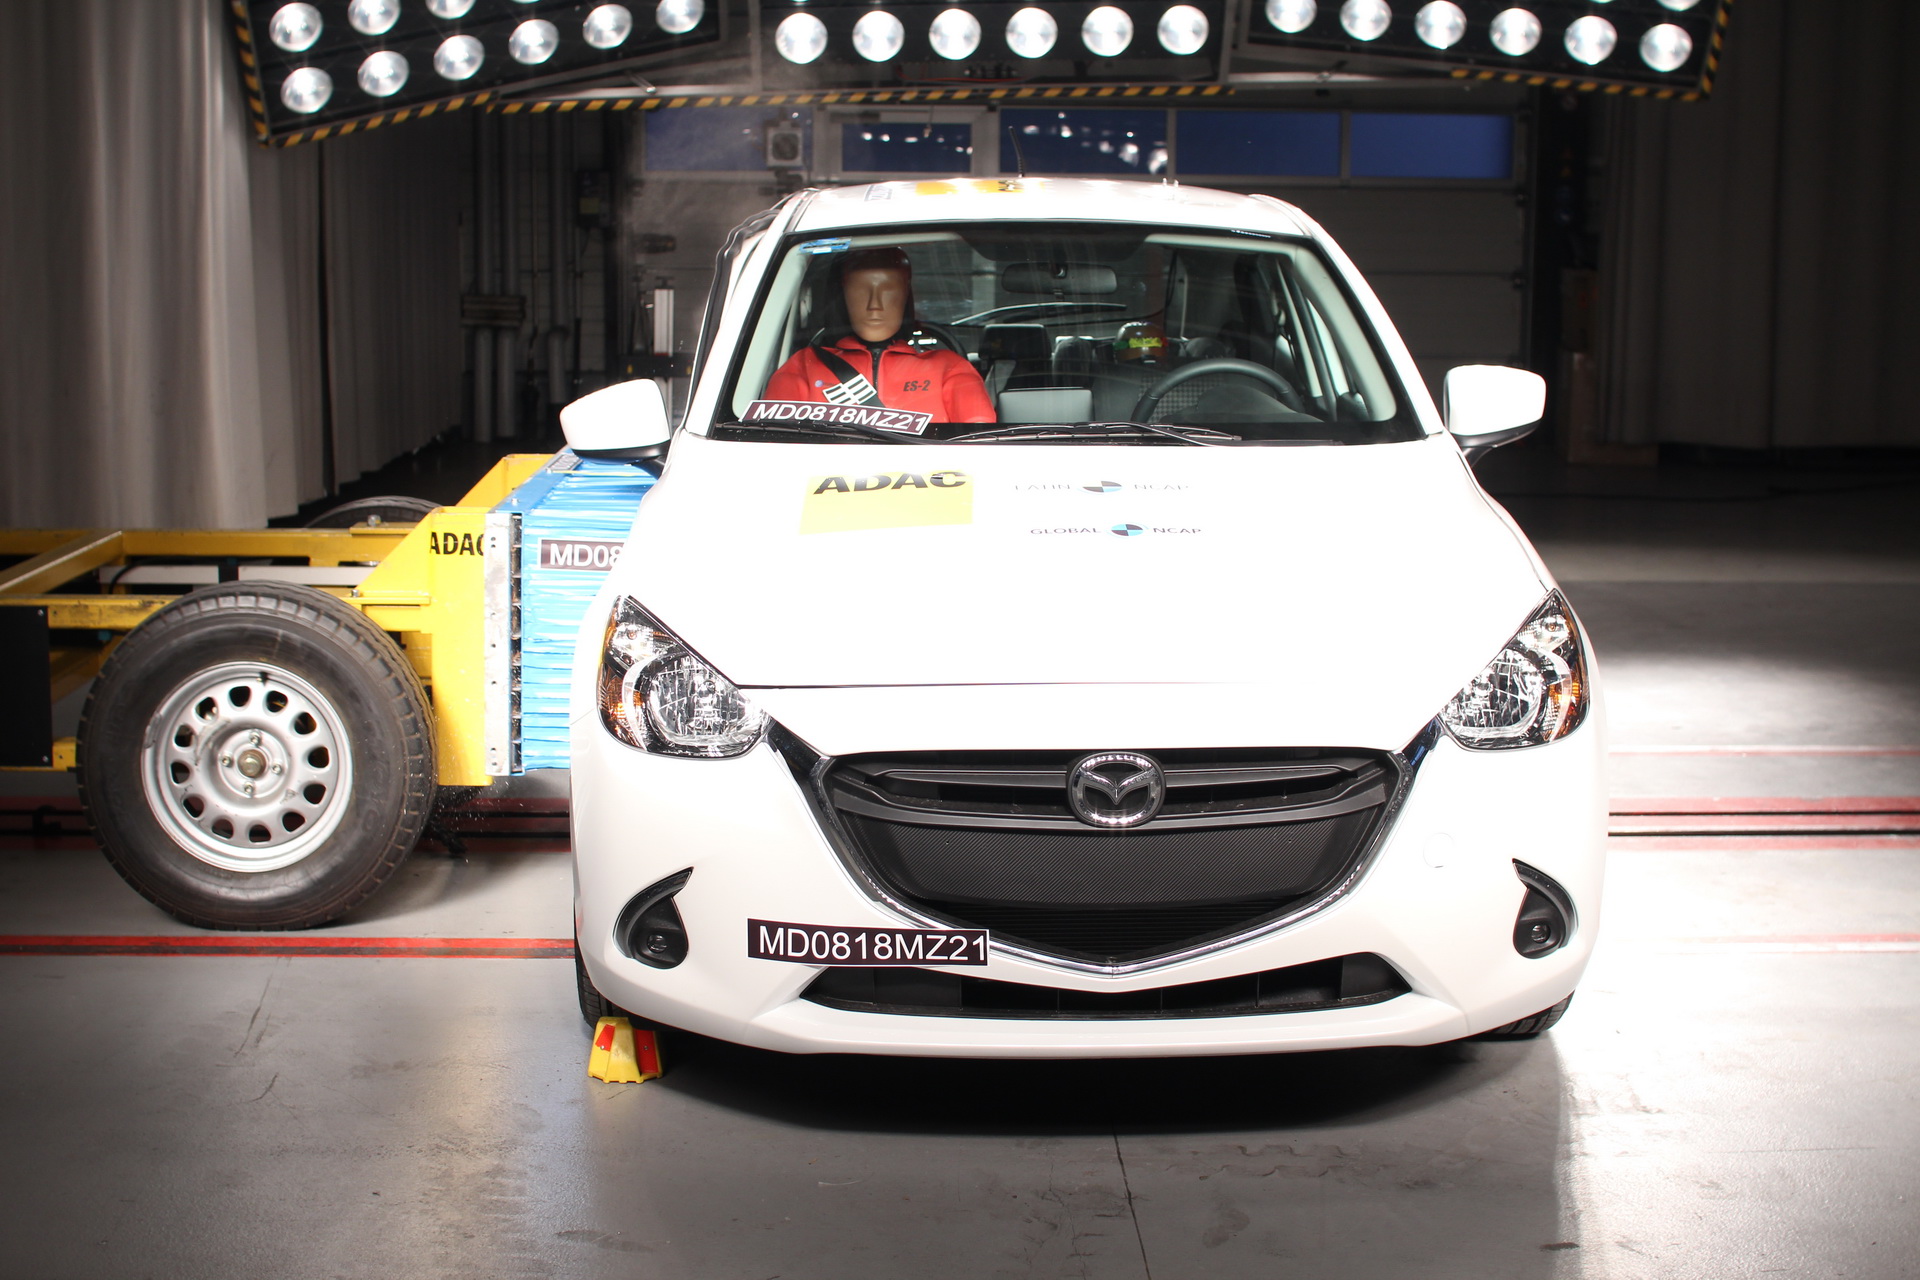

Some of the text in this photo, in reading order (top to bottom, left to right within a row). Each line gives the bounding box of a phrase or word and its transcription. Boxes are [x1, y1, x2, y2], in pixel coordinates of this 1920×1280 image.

[903, 380, 931, 392] ES-2
[752, 403, 927, 431] MD0818MZ21
[813, 471, 966, 495] ADAC
[1030, 526, 1202, 535] GLOBAL NCAP
[759, 925, 985, 961] MD0818MZ21
